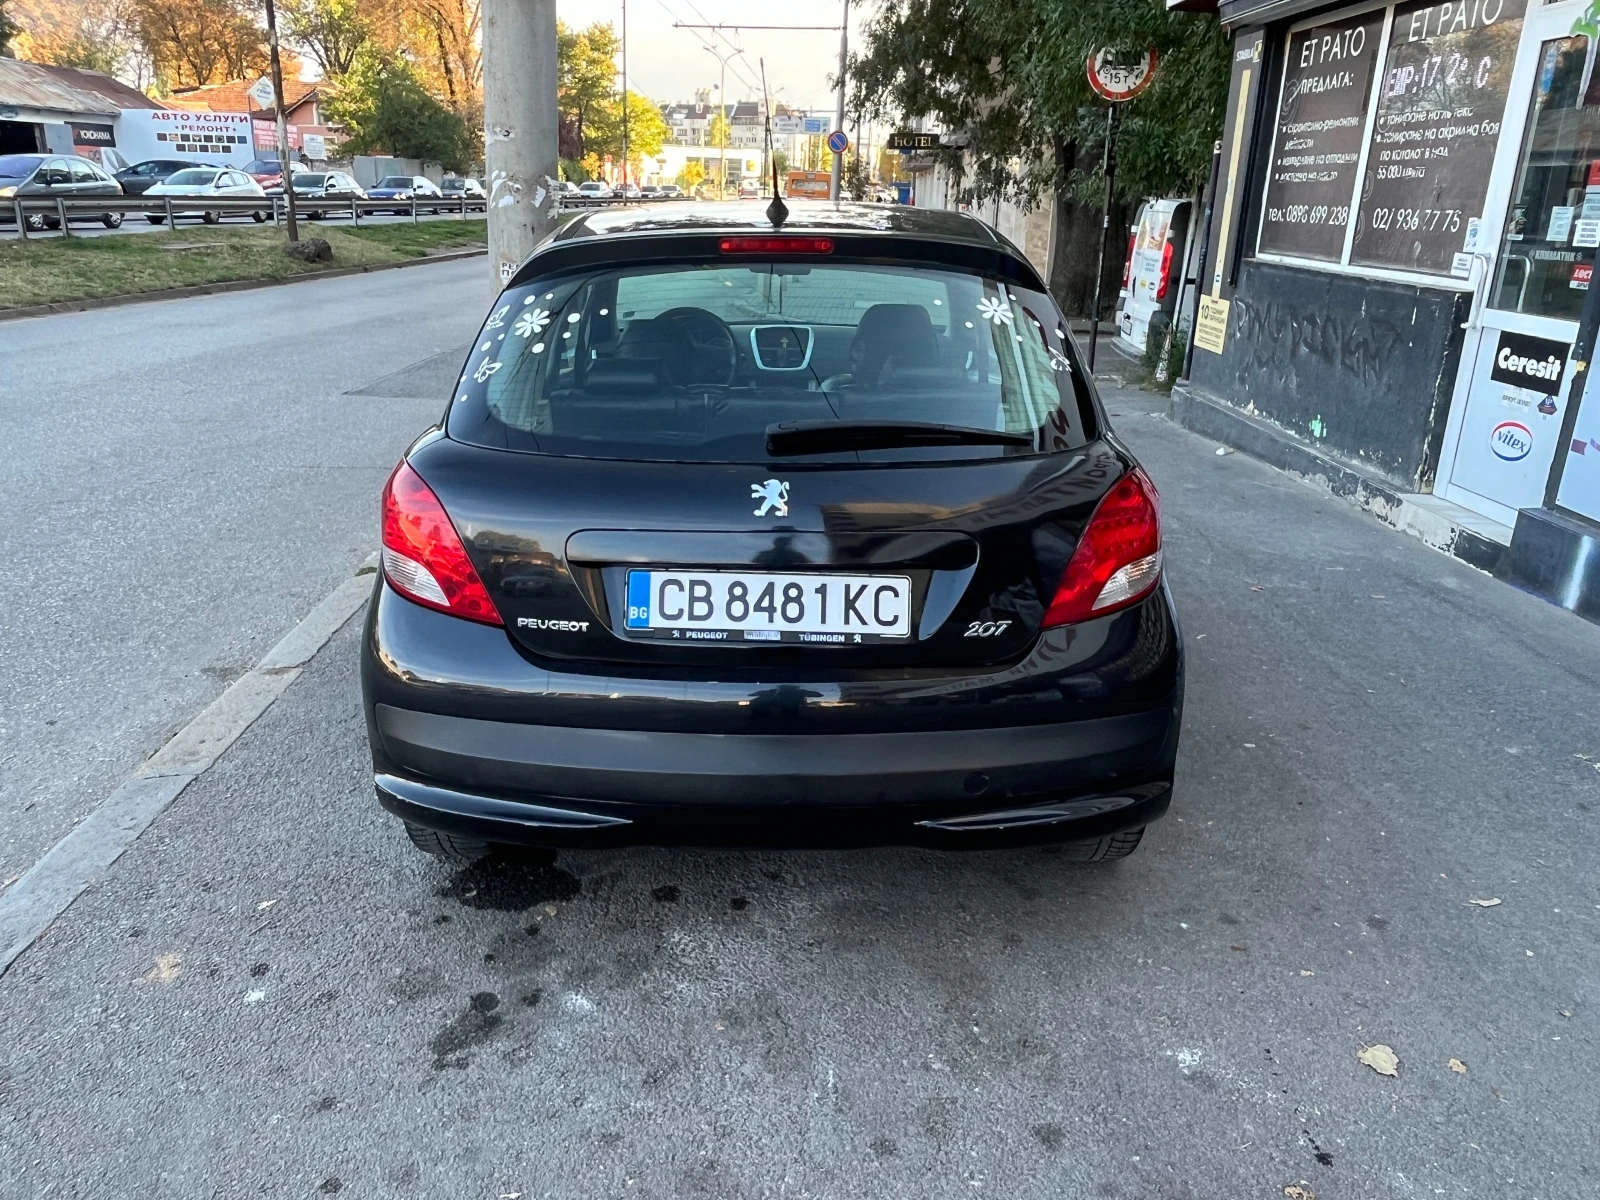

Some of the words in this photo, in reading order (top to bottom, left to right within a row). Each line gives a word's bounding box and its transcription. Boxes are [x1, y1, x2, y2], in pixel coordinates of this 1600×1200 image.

[1299, 71, 1355, 95] ПРЕДЛАГА:
[152, 112, 190, 121] АВТО
[194, 114, 249, 123] УСЛУГИ
[80, 129, 111, 141] YOKOHAMA
[181, 124, 231, 133] РЕМОНТ
[1481, 119, 1500, 137] боя
[894, 136, 934, 148] HOTEL
[1309, 205, 1328, 225] 699
[1328, 205, 1350, 226] 238
[1396, 207, 1420, 231] 936
[1498, 347, 1561, 381] Ceresit
[1497, 430, 1527, 453] vitex
[629, 606, 648, 619] BG
[517, 617, 590, 632] PEUGEOT
[963, 620, 1013, 638] 207
[685, 631, 729, 640] PEUGEOT
[798, 634, 845, 643] TÜBINGEN
